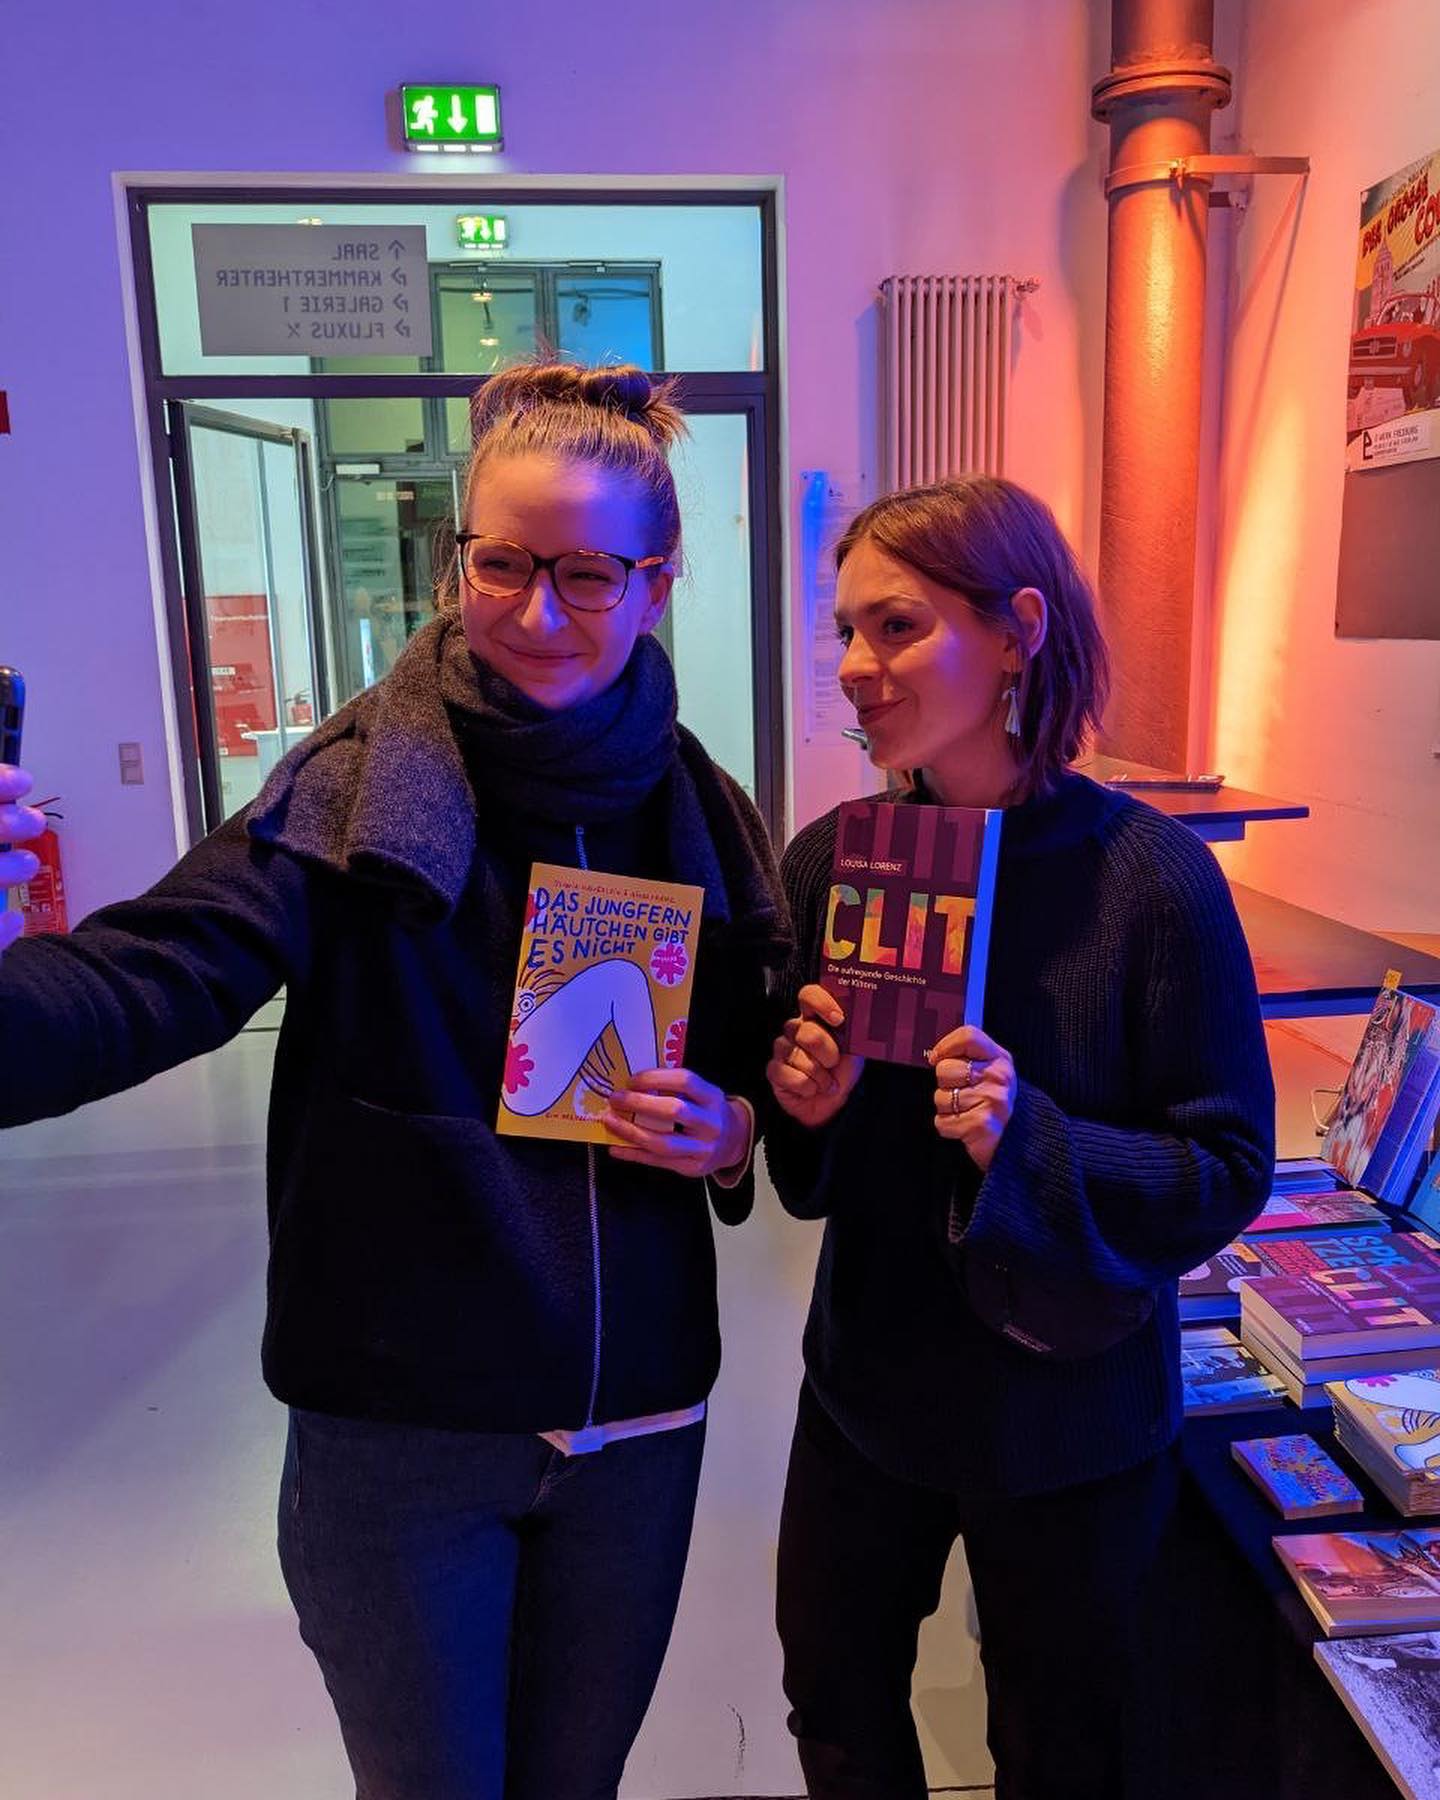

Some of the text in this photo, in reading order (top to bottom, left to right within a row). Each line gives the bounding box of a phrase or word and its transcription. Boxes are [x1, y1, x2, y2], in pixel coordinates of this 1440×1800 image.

[869, 860, 903, 872] LORENZ
[536, 887, 579, 912] DAS
[584, 896, 693, 928] JUNGFERN
[532, 911, 648, 941] HÄUTCHEN
[823, 884, 976, 975] CLIT
[527, 938, 566, 969] ES
[827, 964, 840, 973] Die
[884, 971, 927, 985] Geschichte
[838, 977, 850, 985] der
